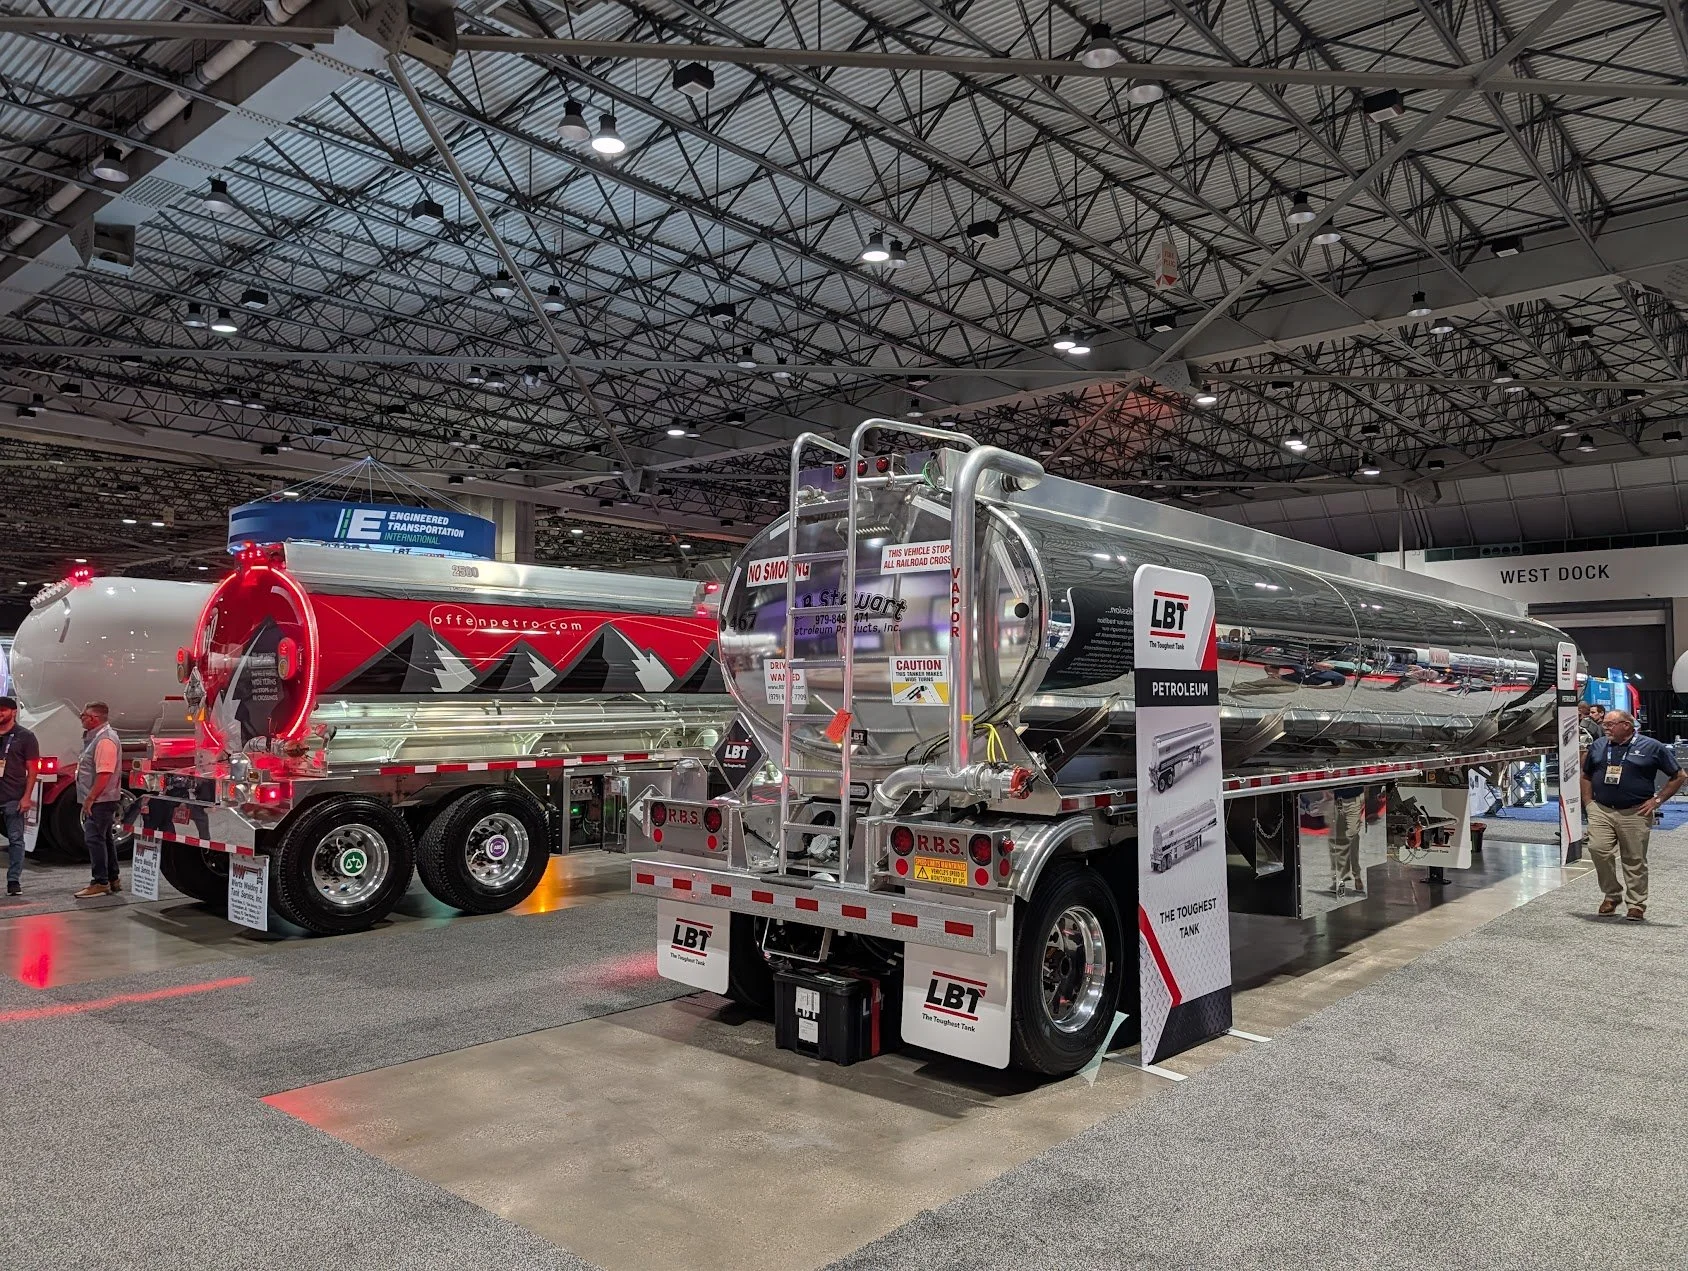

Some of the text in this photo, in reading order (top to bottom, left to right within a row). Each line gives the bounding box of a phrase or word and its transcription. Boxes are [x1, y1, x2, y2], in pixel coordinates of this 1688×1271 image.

[389, 512, 449, 525] ENGINEERED
[387, 522, 465, 538] TRANSPORTATION
[888, 549, 902, 558] THIS
[904, 546, 930, 556] VEHICLE
[452, 565, 479, 577] 2500
[749, 560, 810, 582] NO SMONG
[884, 560, 894, 569] ALL
[896, 557, 928, 568] RAILROAD
[1500, 564, 1610, 584] WEST DOCK
[951, 567, 960, 637] VAPOR
[433, 614, 581, 631] offenpetro.com
[1151, 598, 1188, 630] LBT
[794, 625, 833, 636] etroleum
[883, 622, 901, 632] Inc.
[896, 660, 942, 670] CAUTION
[1152, 681, 1209, 696] PETROLEUM
[725, 744, 749, 759] LBT
[669, 808, 701, 825] R.B.S.
[917, 835, 964, 856] R.B.S.
[1159, 898, 1217, 924] THE TOUGHEST
[673, 924, 713, 951] LBT
[1179, 922, 1200, 938] TANK
[925, 978, 987, 1014] LBT
[921, 1012, 976, 1032] The Toughest Tank
